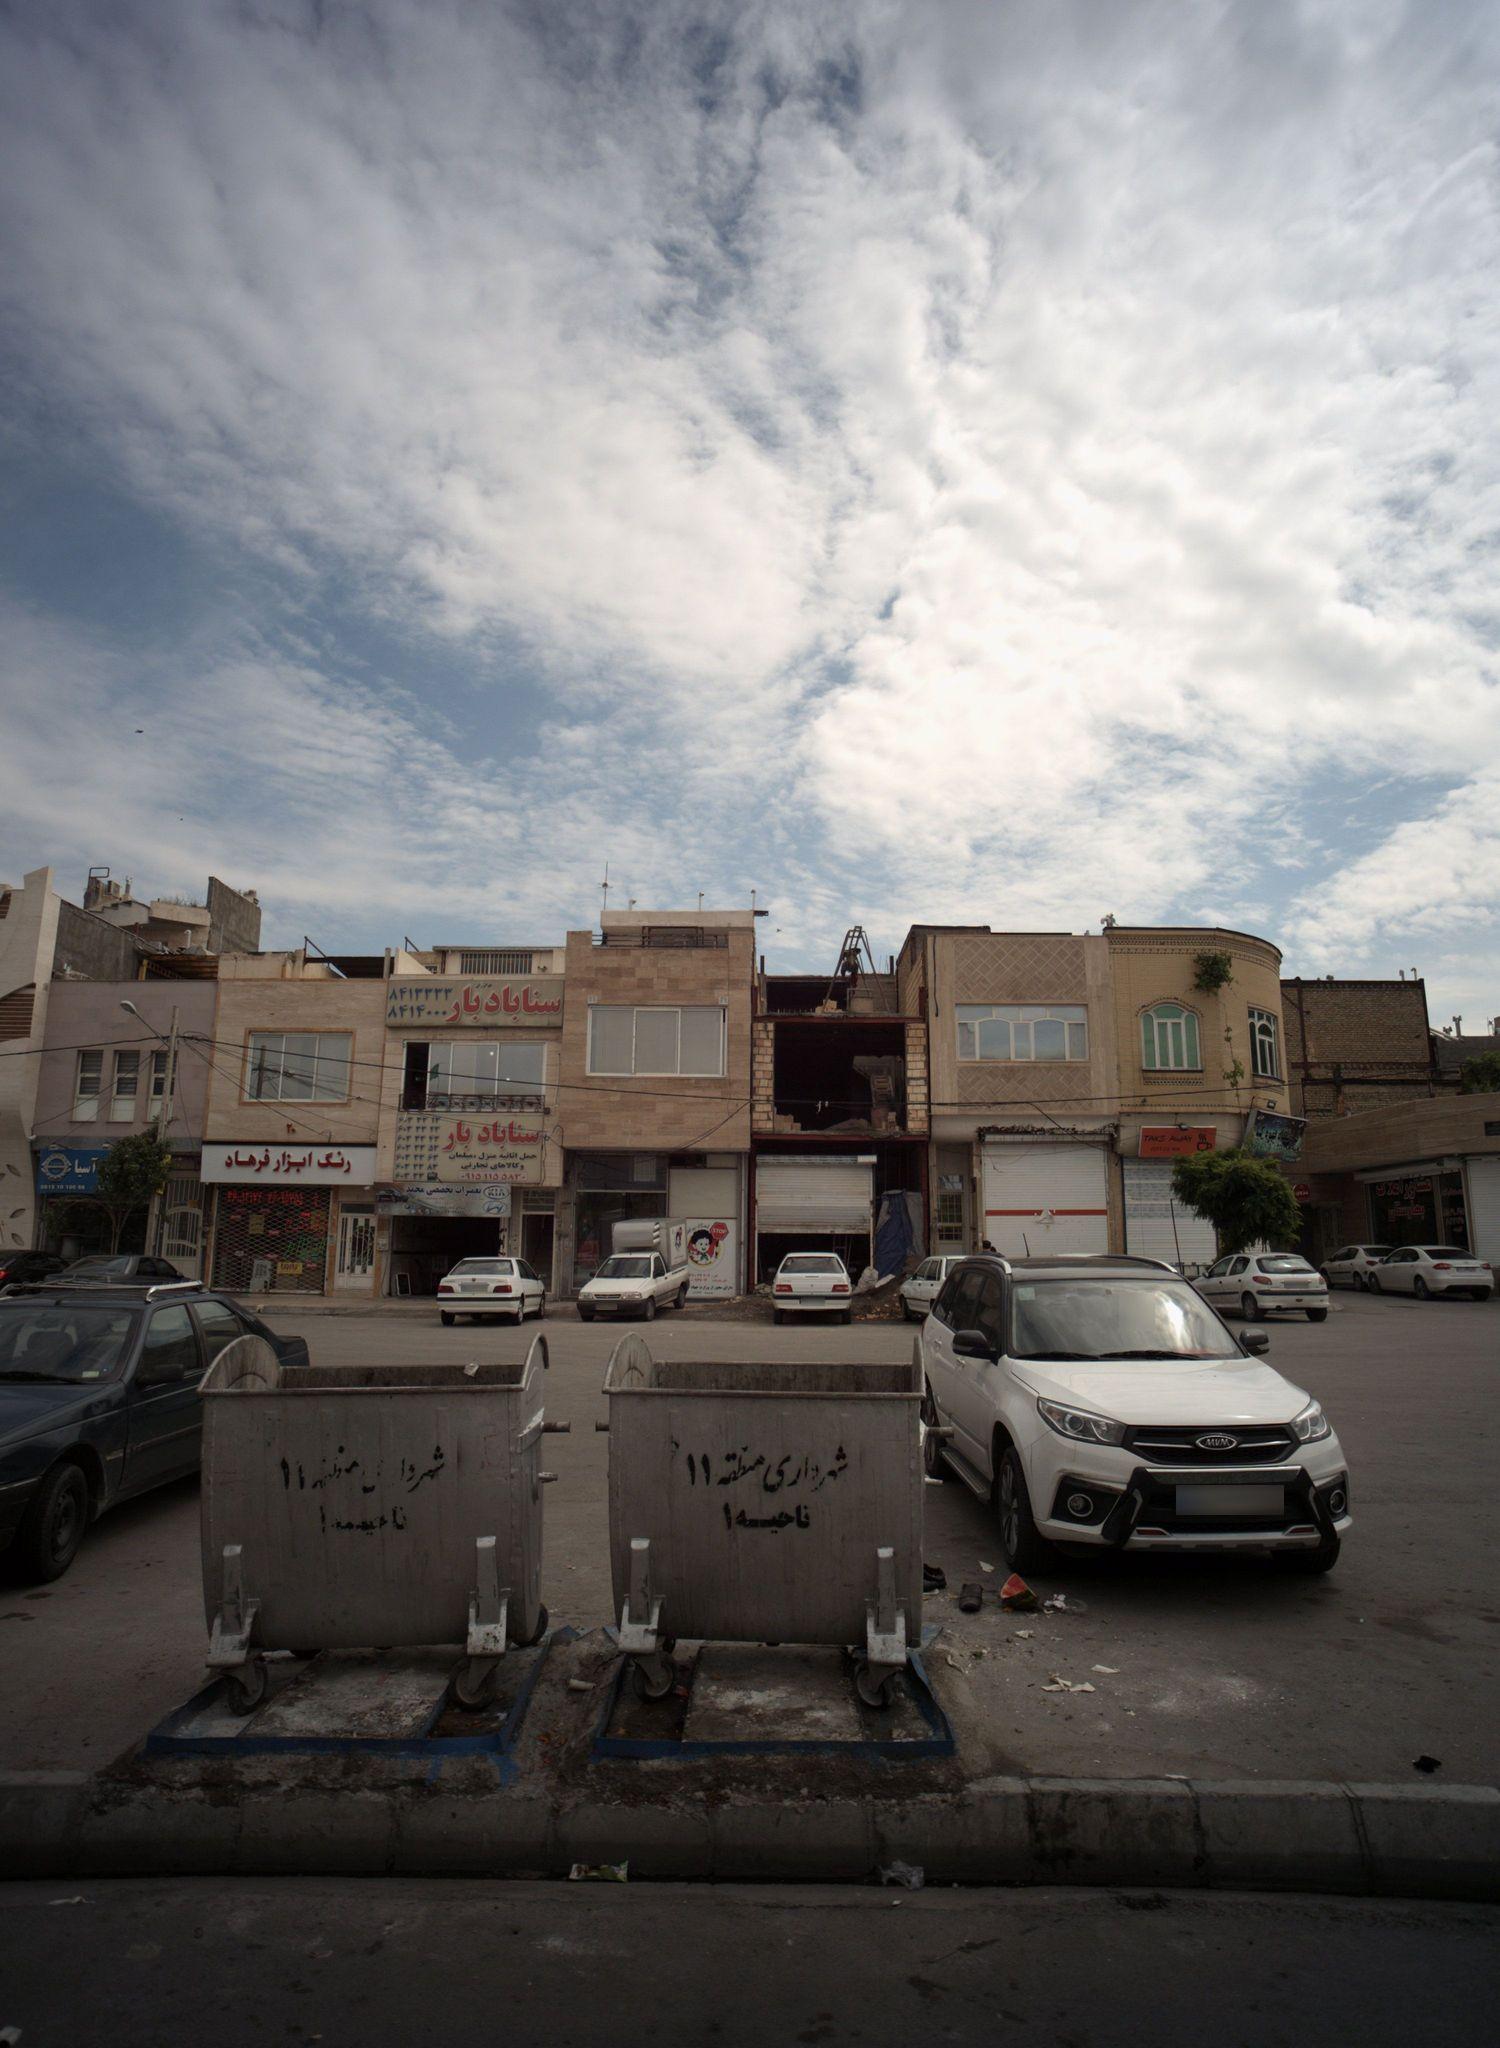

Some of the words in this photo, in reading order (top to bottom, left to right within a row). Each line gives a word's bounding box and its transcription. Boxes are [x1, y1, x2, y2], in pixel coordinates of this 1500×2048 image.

[387, 1004, 448, 1019] ۸۴۱۴۰۰۰
[445, 985, 481, 1023] بار
[484, 984, 561, 1022] سناباد
[441, 1120, 470, 1151] بار
[478, 1120, 540, 1149] سناباد
[73, 1156, 99, 1178] آسیا
[224, 1148, 270, 1172] فرهاد
[273, 1150, 313, 1173] ابزار
[317, 1151, 352, 1173] رنگ
[1204, 1438, 1230, 1446] MVM
[281, 1457, 305, 1490] ۱۱
[687, 1453, 711, 1486] ۱۱
[717, 1445, 765, 1486] منطقه
[723, 1502, 732, 1530] ۱
